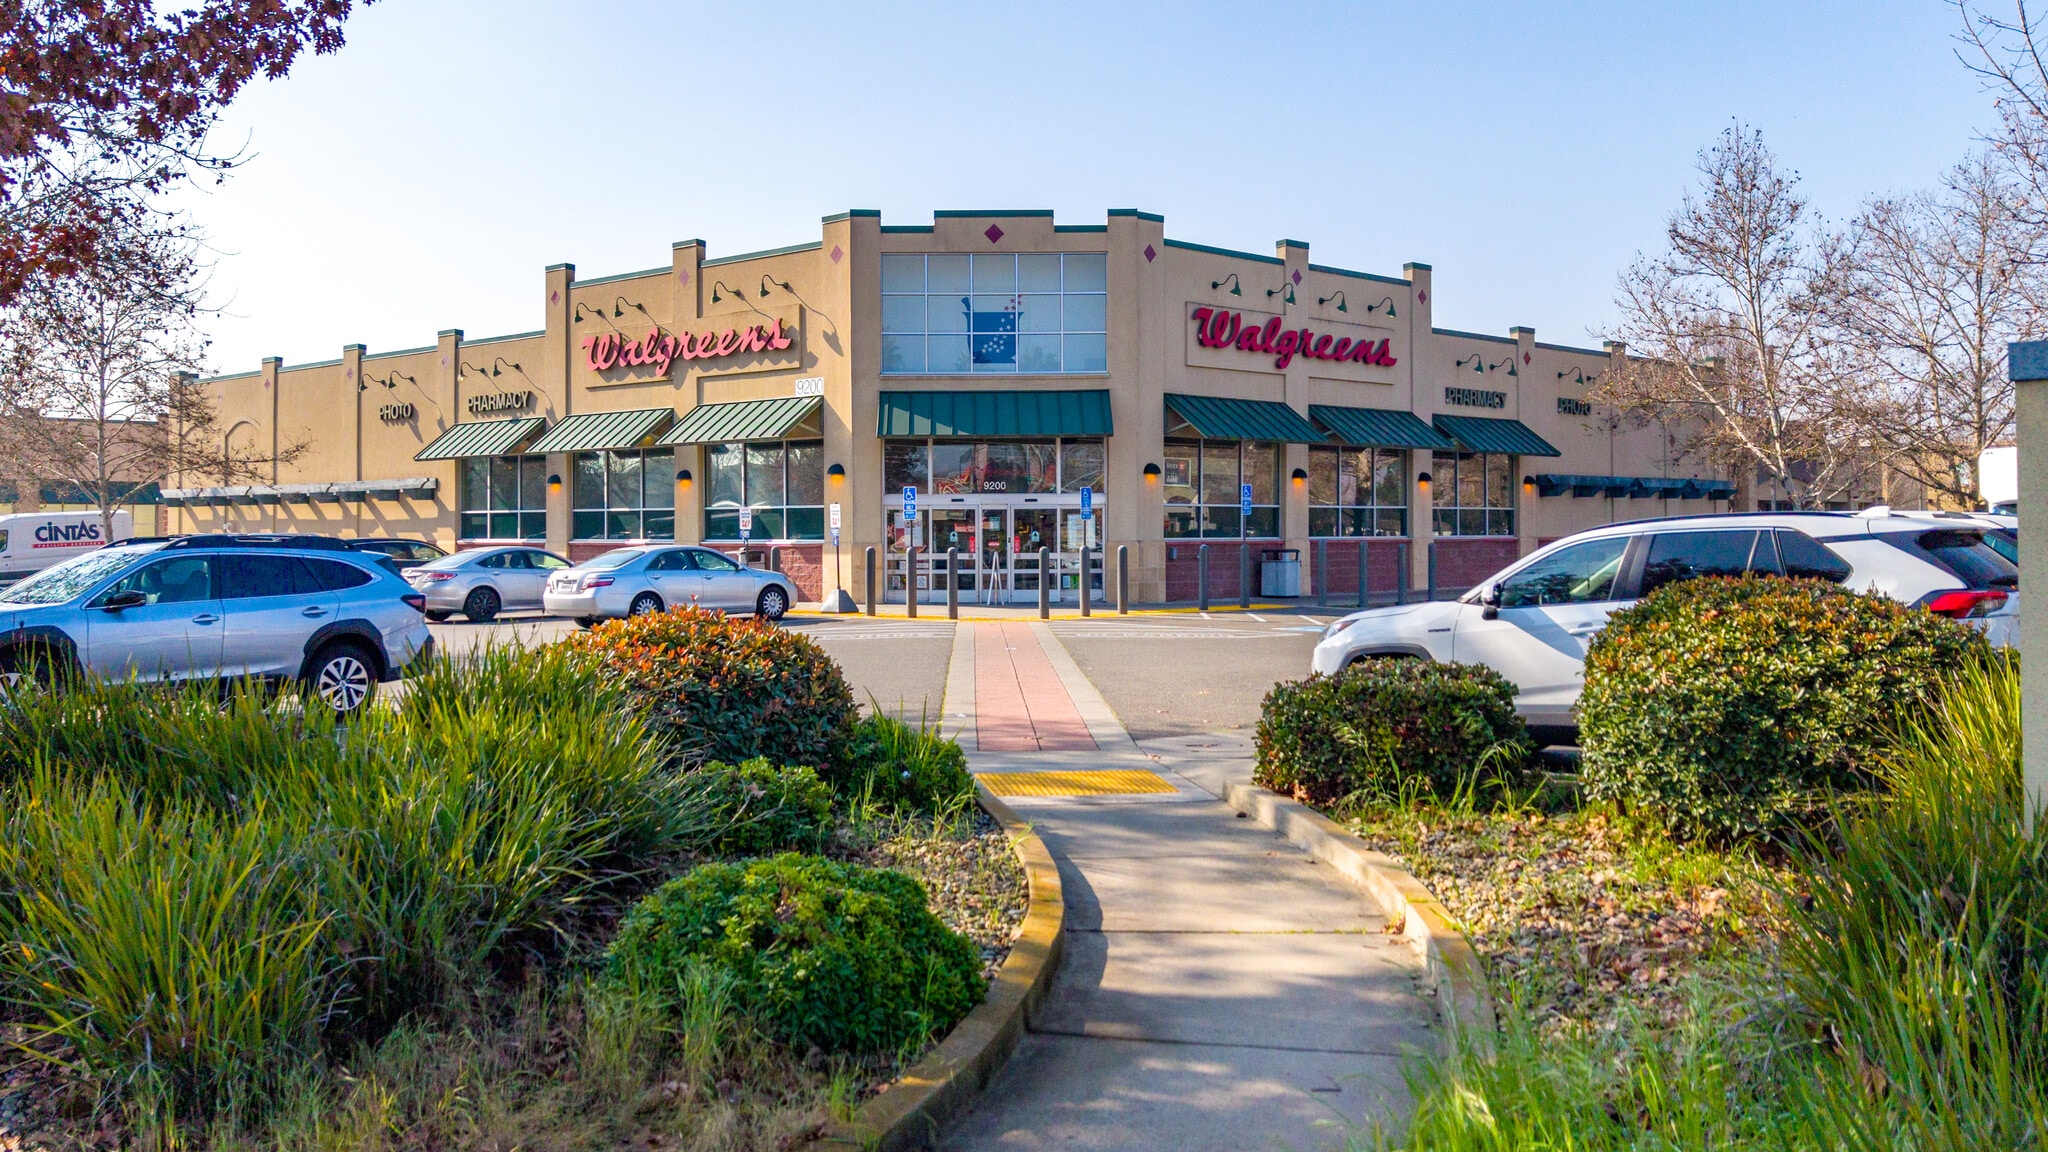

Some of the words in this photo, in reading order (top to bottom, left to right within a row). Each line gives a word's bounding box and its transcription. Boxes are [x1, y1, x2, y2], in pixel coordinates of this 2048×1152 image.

[582, 317, 793, 377] Walgreens
[1193, 307, 1398, 370] Walgreens
[796, 378, 823, 395] 9200
[468, 391, 531, 412] PHARMACY
[1446, 387, 1507, 409] PHARMACY
[1558, 397, 1591, 416] PHOTO
[379, 402, 412, 420] PHOTO
[983, 481, 1006, 490] 9200
